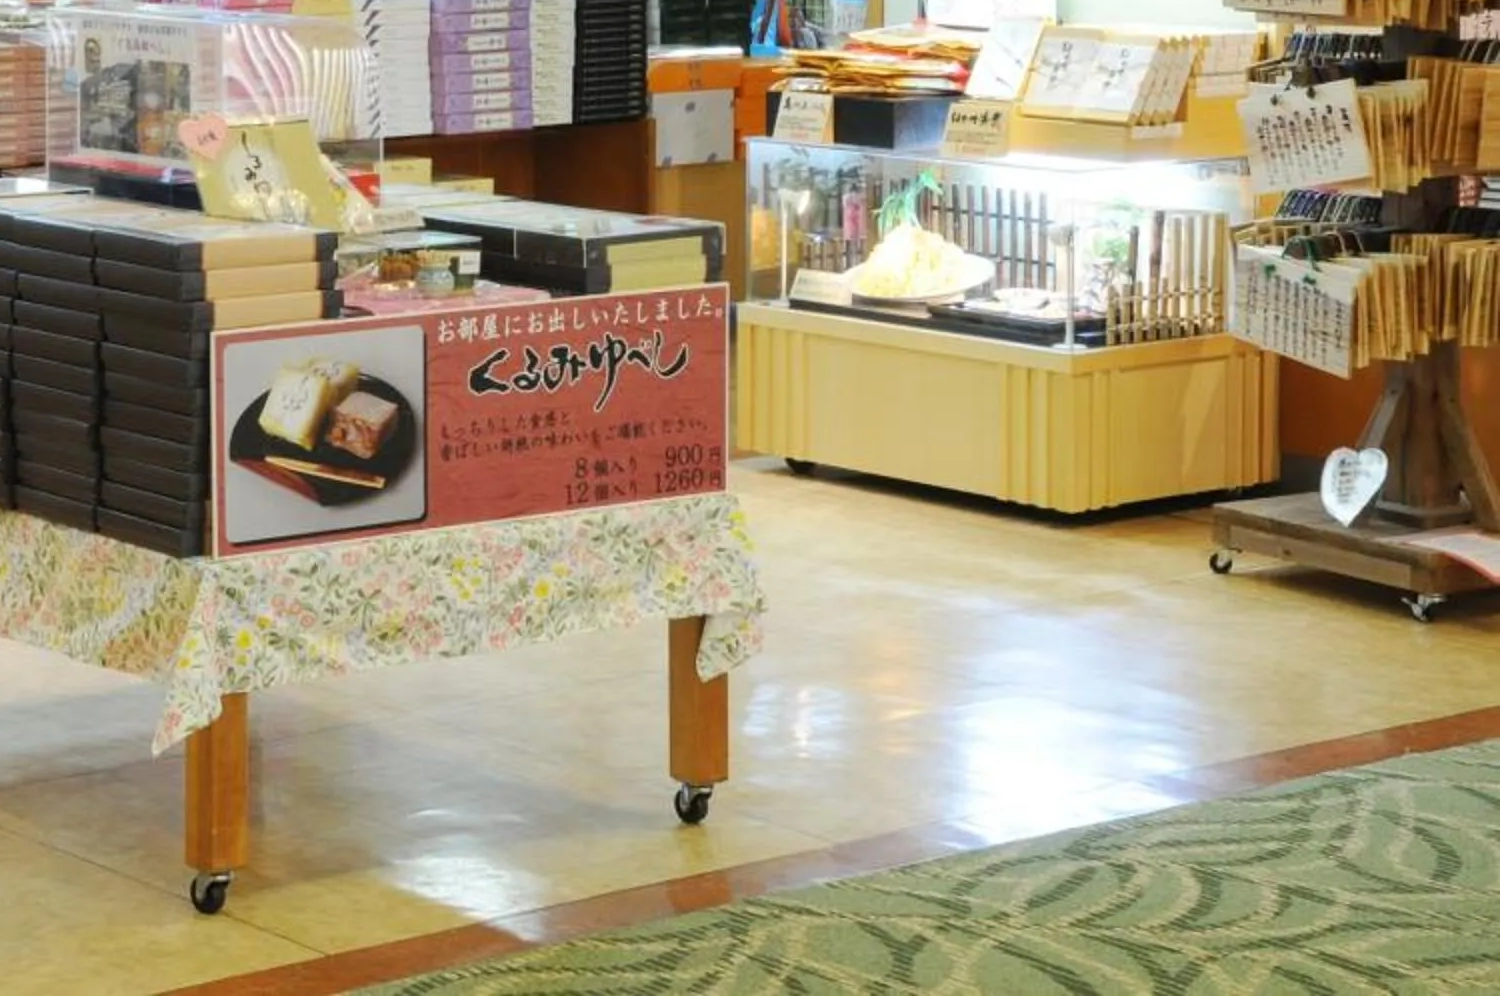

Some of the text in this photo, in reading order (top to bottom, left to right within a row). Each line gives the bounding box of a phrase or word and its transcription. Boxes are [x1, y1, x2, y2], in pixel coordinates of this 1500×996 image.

[437, 293, 724, 343] お部屋にお出しいたしました。
[468, 329, 689, 412] くるみゆべし
[664, 444, 722, 469] 900円
[654, 468, 722, 495] 1260円
